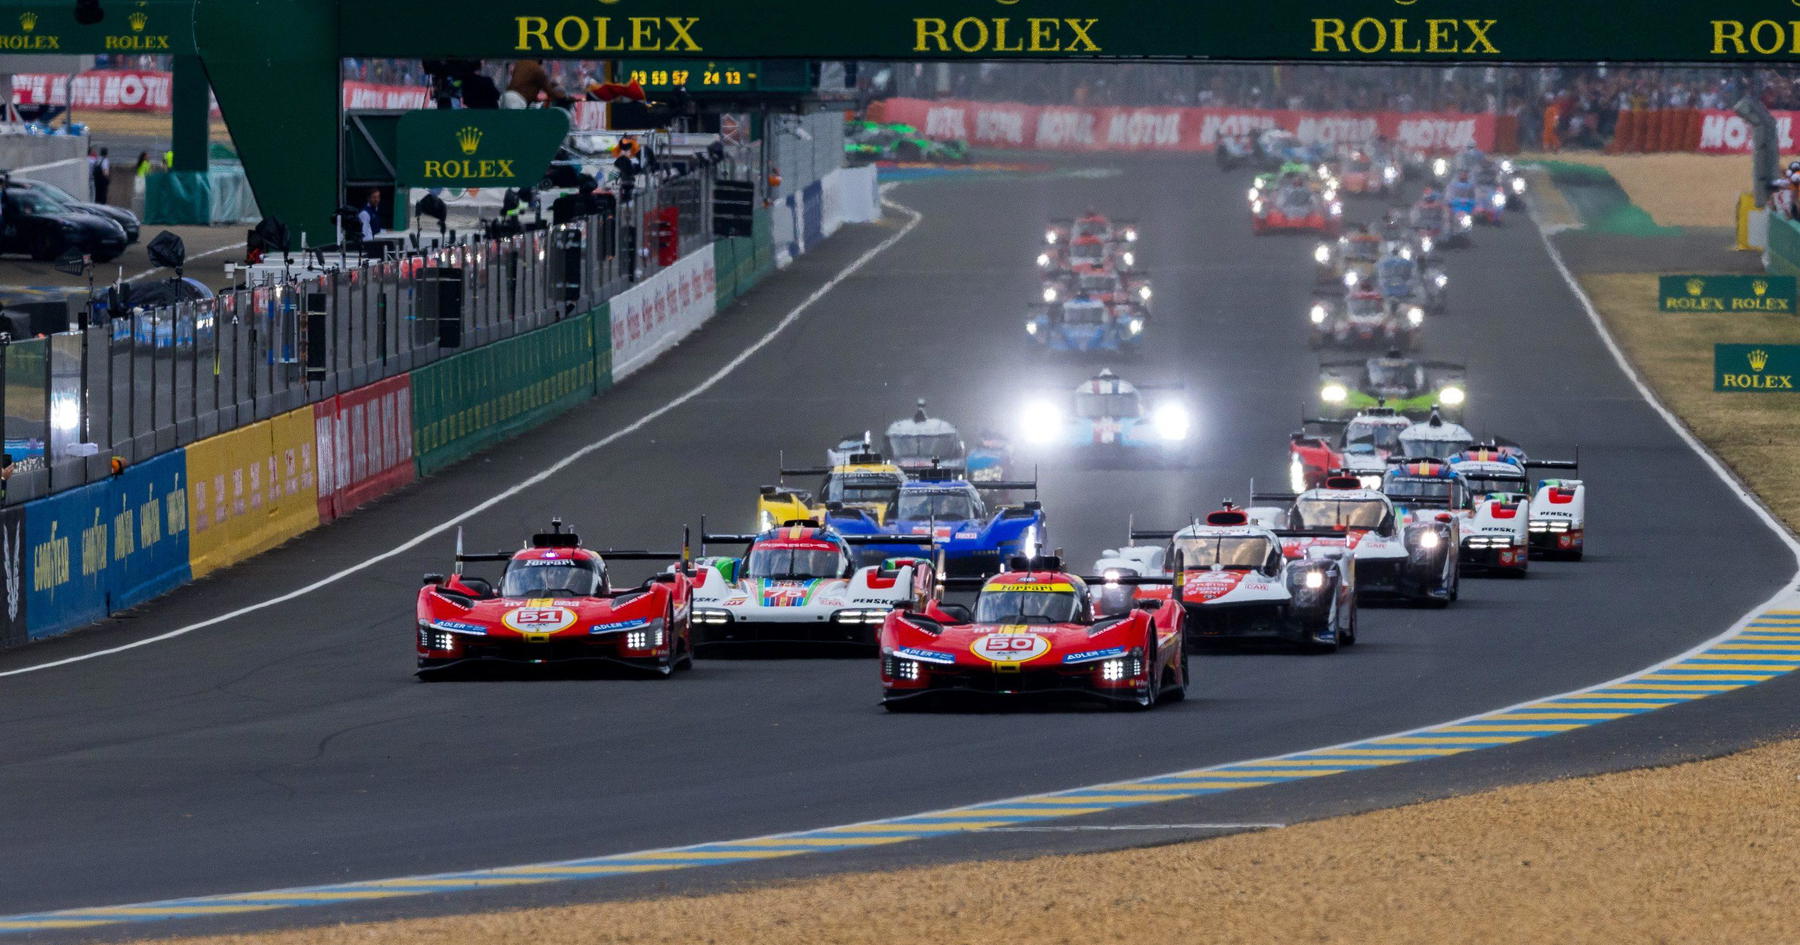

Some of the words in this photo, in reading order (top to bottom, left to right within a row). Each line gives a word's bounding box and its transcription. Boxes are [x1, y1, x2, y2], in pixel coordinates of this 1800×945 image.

[515, 16, 703, 53] ROLEX
[914, 17, 1100, 53] ROLEX
[1312, 17, 1499, 54] ROLEX
[105, 35, 169, 49] ROLEX
[423, 159, 515, 179] ROLEX
[1666, 297, 1724, 311] ROLEX
[1732, 297, 1789, 311] ROLEX
[1723, 373, 1793, 389] ROLEX
[1481, 526, 1516, 534] PENSKE
[524, 559, 576, 567] Ferrari
[519, 611, 560, 622] 51
[438, 621, 466, 630] ADLER
[593, 622, 623, 632] ADLER
[988, 638, 1033, 650] 50
[903, 648, 934, 657] ADLER
[1066, 650, 1099, 660] ADLER
